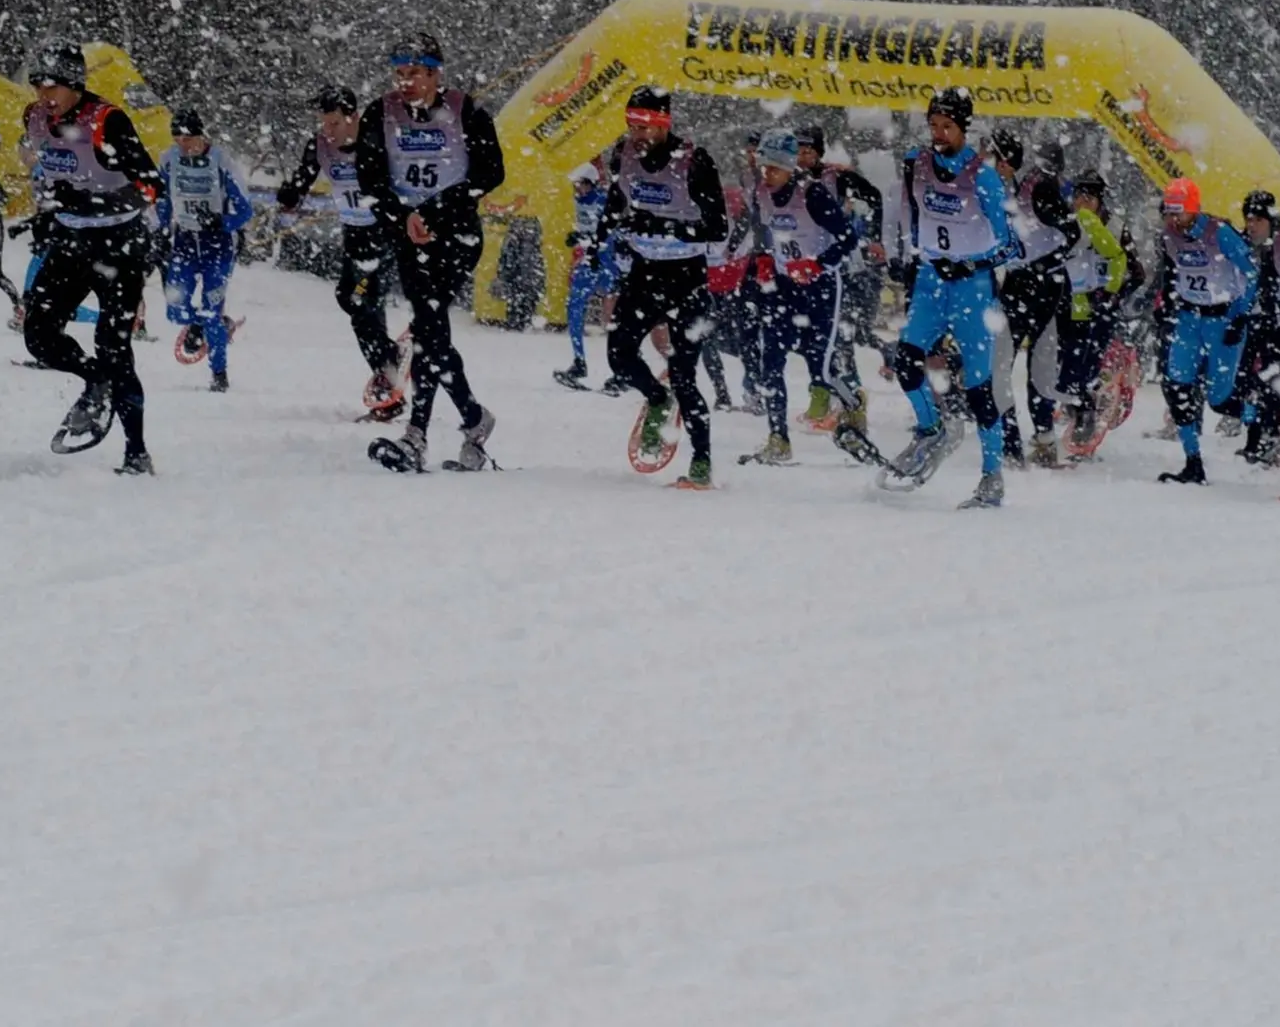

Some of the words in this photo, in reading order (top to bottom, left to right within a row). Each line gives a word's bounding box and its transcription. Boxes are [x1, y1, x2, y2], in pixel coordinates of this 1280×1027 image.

[686, 2, 1047, 70] TRENTINGRANA
[823, 73, 840, 95] il
[850, 77, 935, 99] nostro
[406, 163, 438, 188] 45
[1186, 275, 1208, 291] 22
